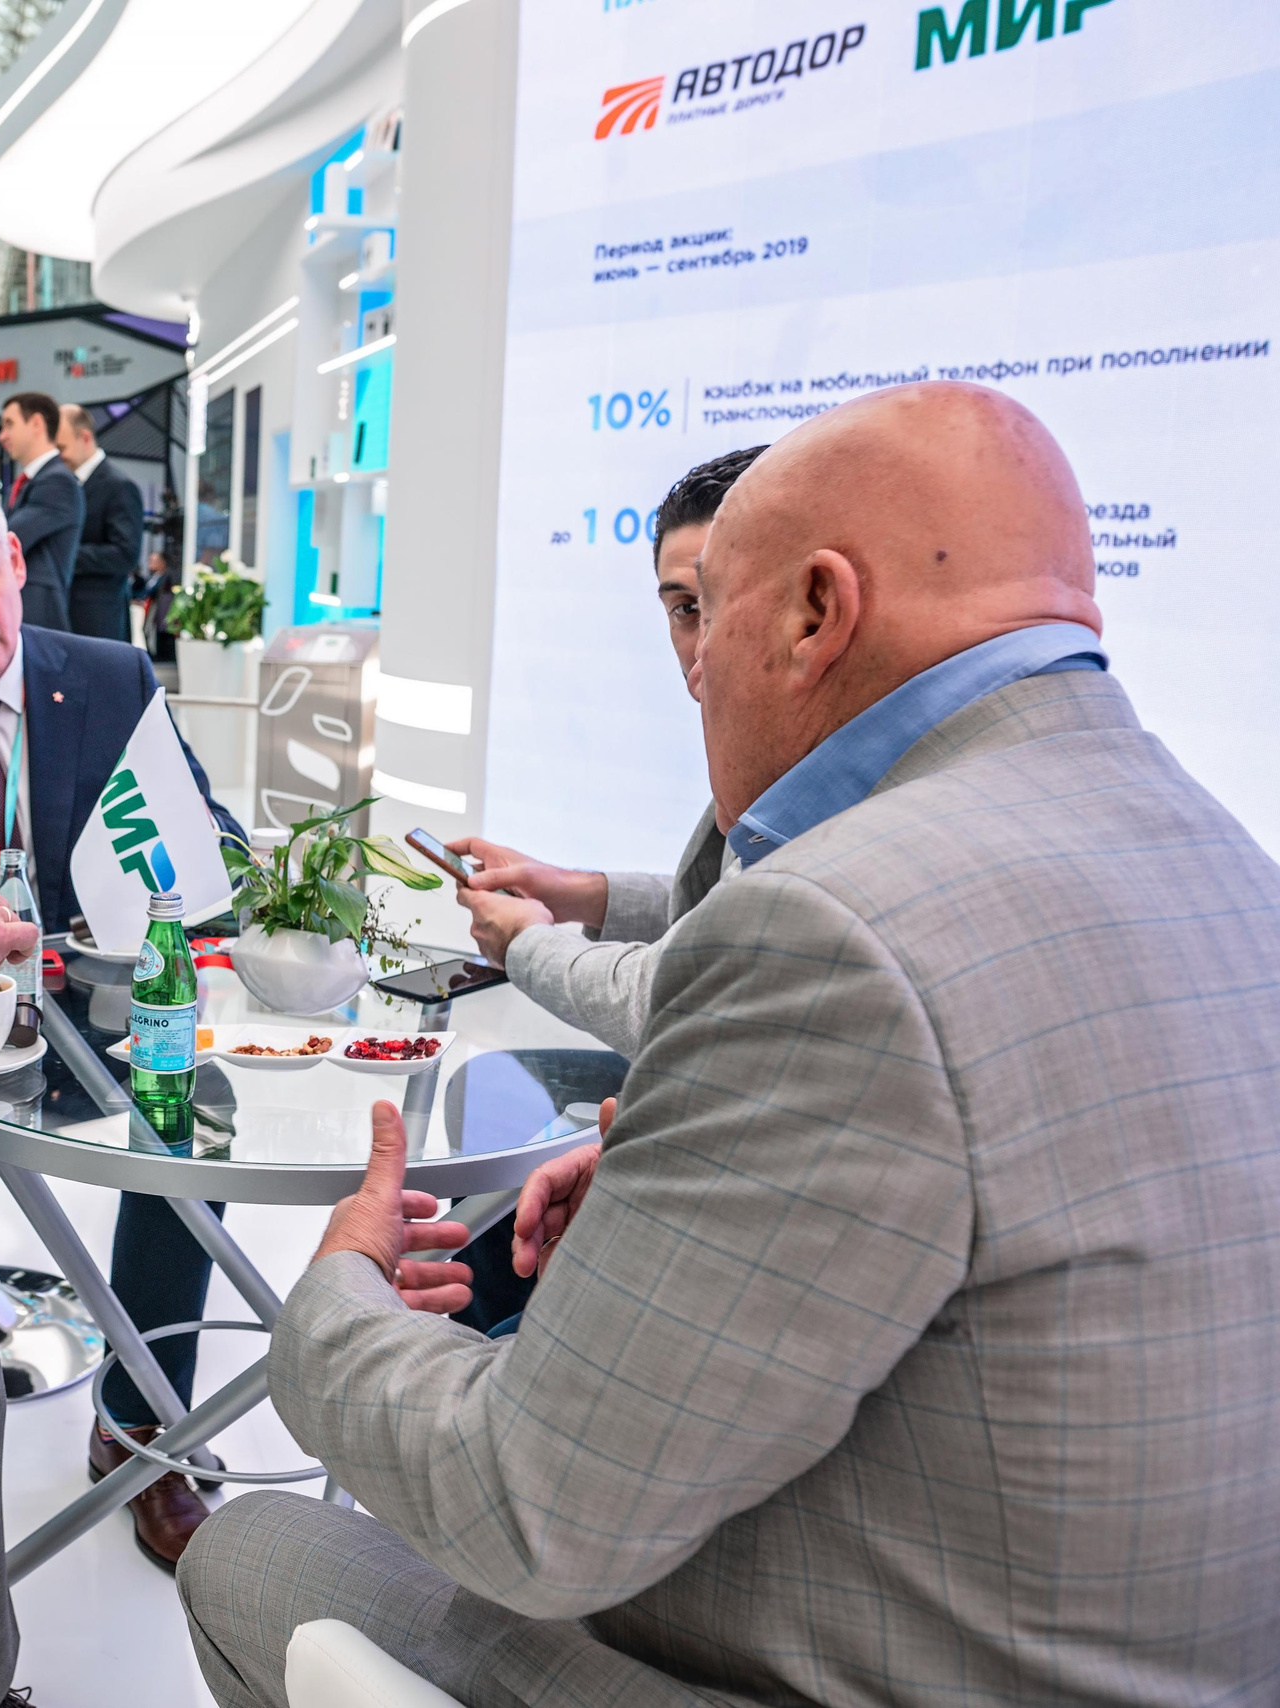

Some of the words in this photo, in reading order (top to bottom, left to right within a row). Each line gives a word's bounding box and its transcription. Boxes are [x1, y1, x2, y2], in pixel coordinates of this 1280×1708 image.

[673, 24, 865, 103] АВТОДОР
[594, 268, 639, 282] июнь
[667, 249, 756, 273] сентябрь
[762, 237, 808, 260] 2019
[595, 239, 663, 260] Период
[587, 388, 671, 431] 10%
[704, 378, 774, 400] кэшбэк
[781, 380, 803, 393] на
[810, 366, 929, 394] мобильный
[938, 358, 1038, 380] телефон
[1046, 356, 1092, 377] при
[1101, 339, 1270, 369] пополнении
[551, 531, 571, 544] до
